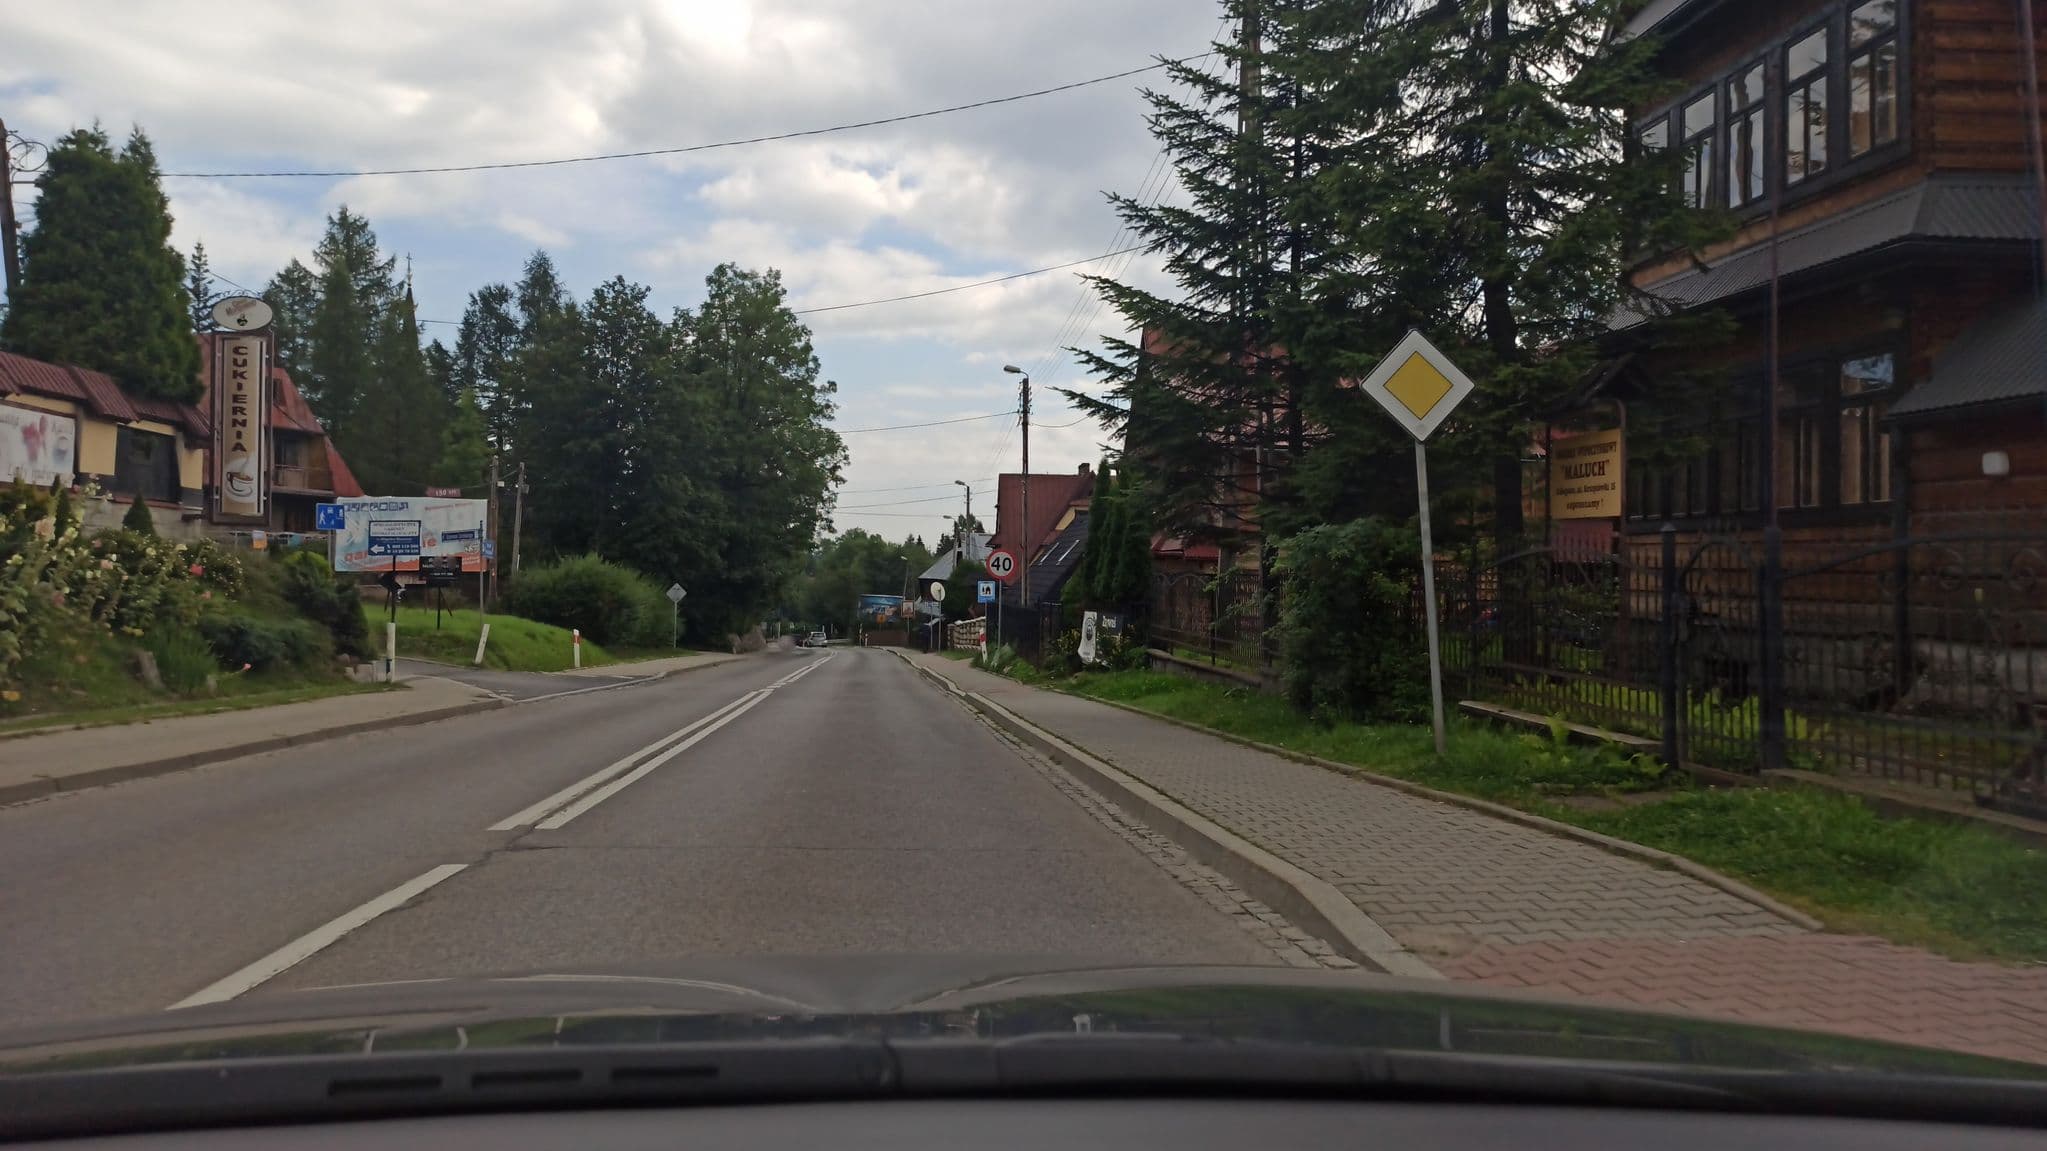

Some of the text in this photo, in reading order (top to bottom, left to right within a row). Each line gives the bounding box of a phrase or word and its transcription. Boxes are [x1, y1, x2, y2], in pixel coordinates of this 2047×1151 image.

[231, 345, 248, 453] CUKIERNIA
[1561, 460, 1610, 479] "MALUCH"
[991, 556, 1012, 572] 40
